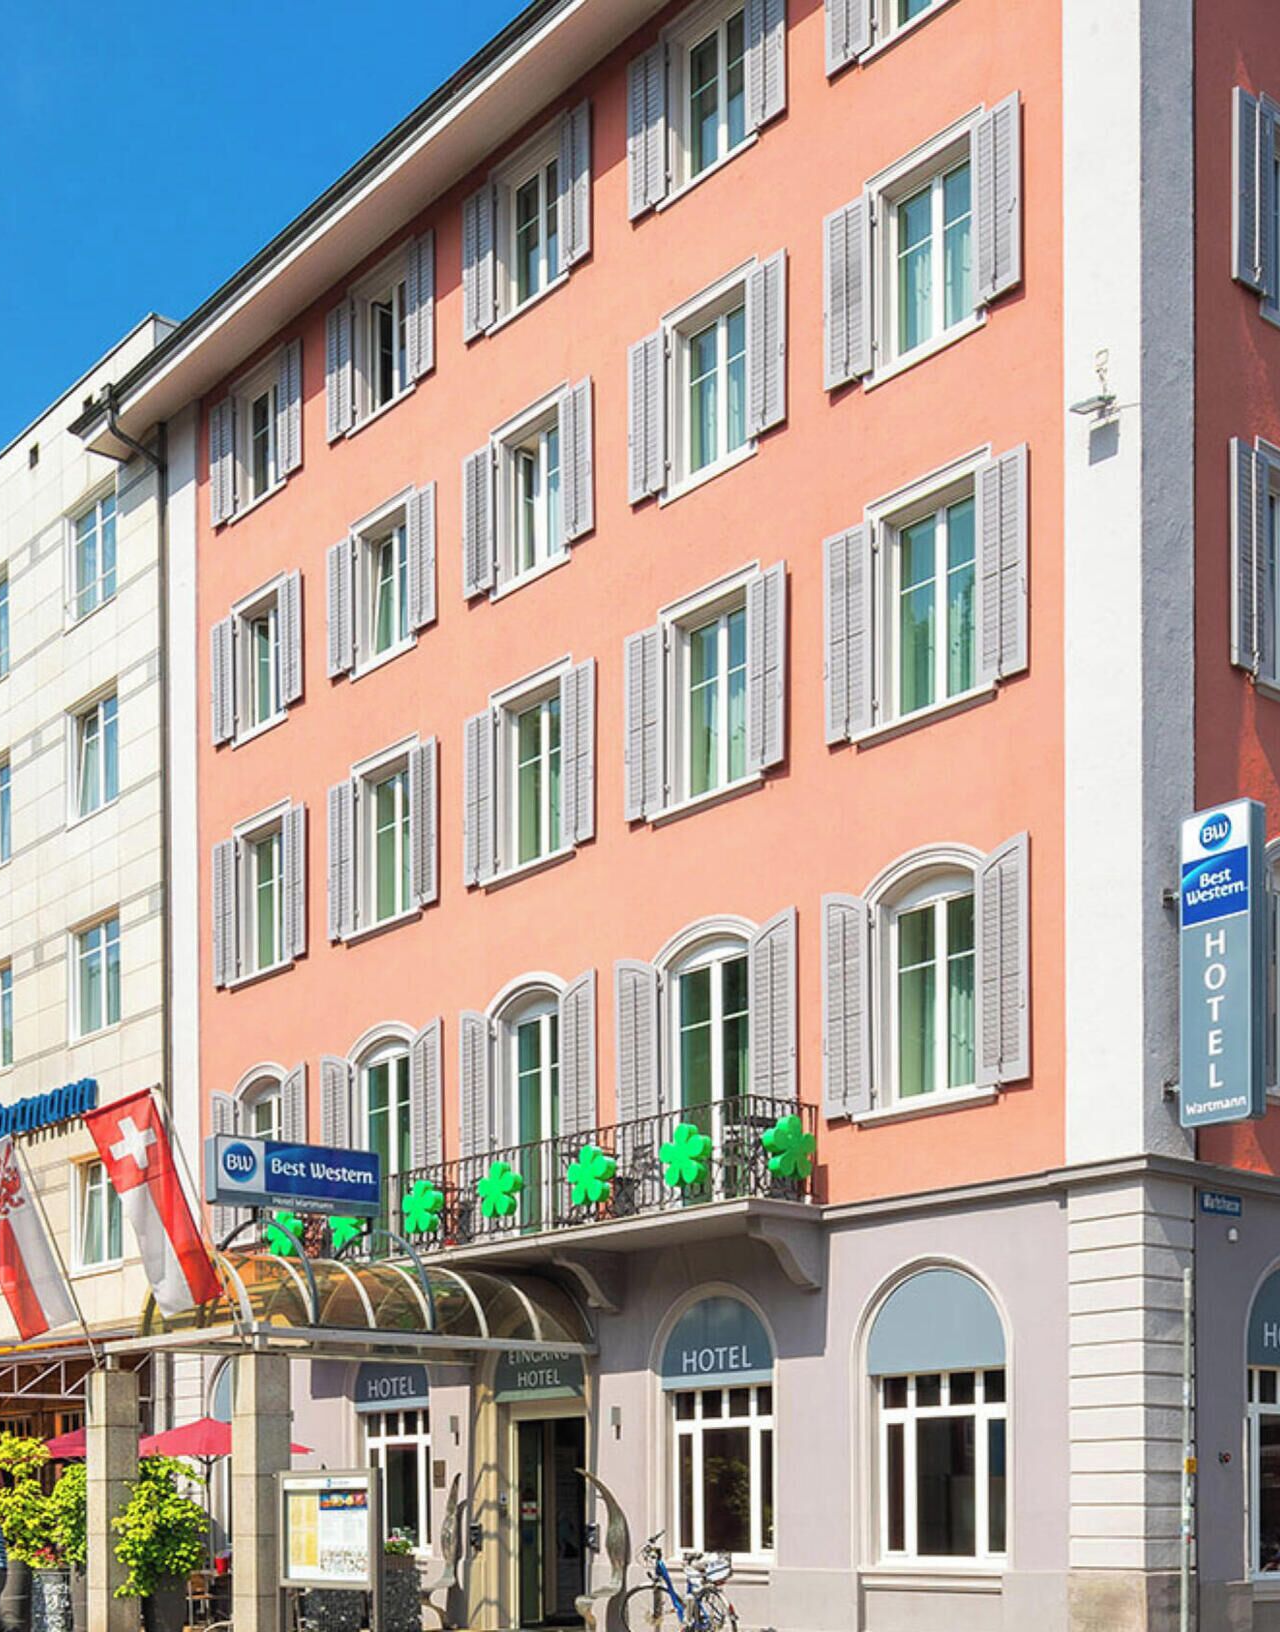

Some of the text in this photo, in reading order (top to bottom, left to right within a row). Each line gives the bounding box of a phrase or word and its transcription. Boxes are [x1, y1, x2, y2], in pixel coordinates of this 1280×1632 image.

[1203, 821, 1228, 844] BW
[1200, 868, 1232, 888] Best
[1186, 880, 1244, 906] Western
[1204, 929, 1227, 1089] HOTEL
[1185, 1095, 1247, 1116] Wartmann
[226, 1154, 254, 1172] BW
[271, 1158, 375, 1184] Best Western
[682, 1345, 753, 1373] HOTEL
[367, 1376, 416, 1399] HOTEL
[517, 1368, 561, 1388] HOTEL
